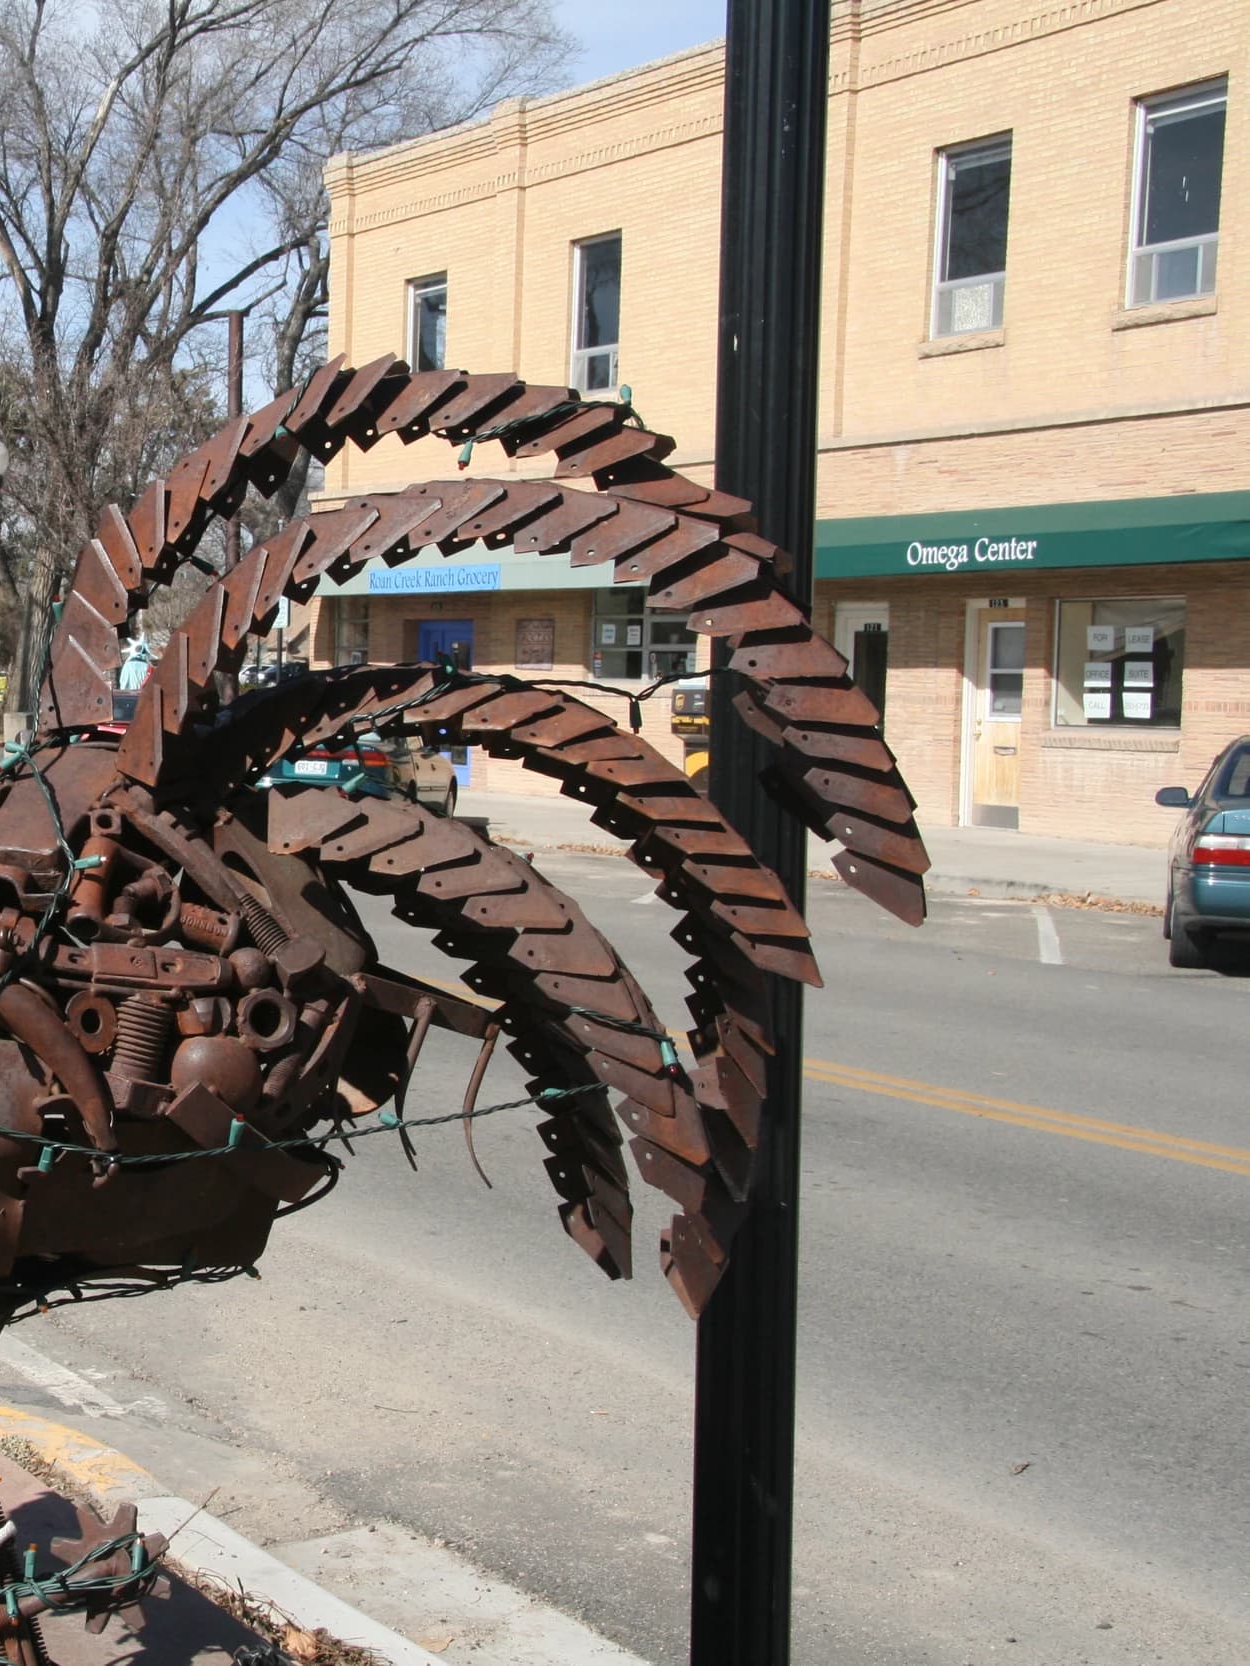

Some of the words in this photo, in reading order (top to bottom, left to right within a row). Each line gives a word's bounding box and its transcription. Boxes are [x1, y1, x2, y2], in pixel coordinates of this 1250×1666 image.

[906, 541, 969, 570] Omega
[974, 537, 1037, 562] Center
[369, 572, 391, 589] Roan
[394, 570, 422, 589] Creek
[424, 568, 455, 588] Ranch
[457, 568, 498, 590] Grocery
[1128, 634, 1151, 643] LEASE
[1085, 670, 1110, 679] OFFICE
[1127, 670, 1149, 679] SUITE
[180, 915, 228, 937] JOHNSON
